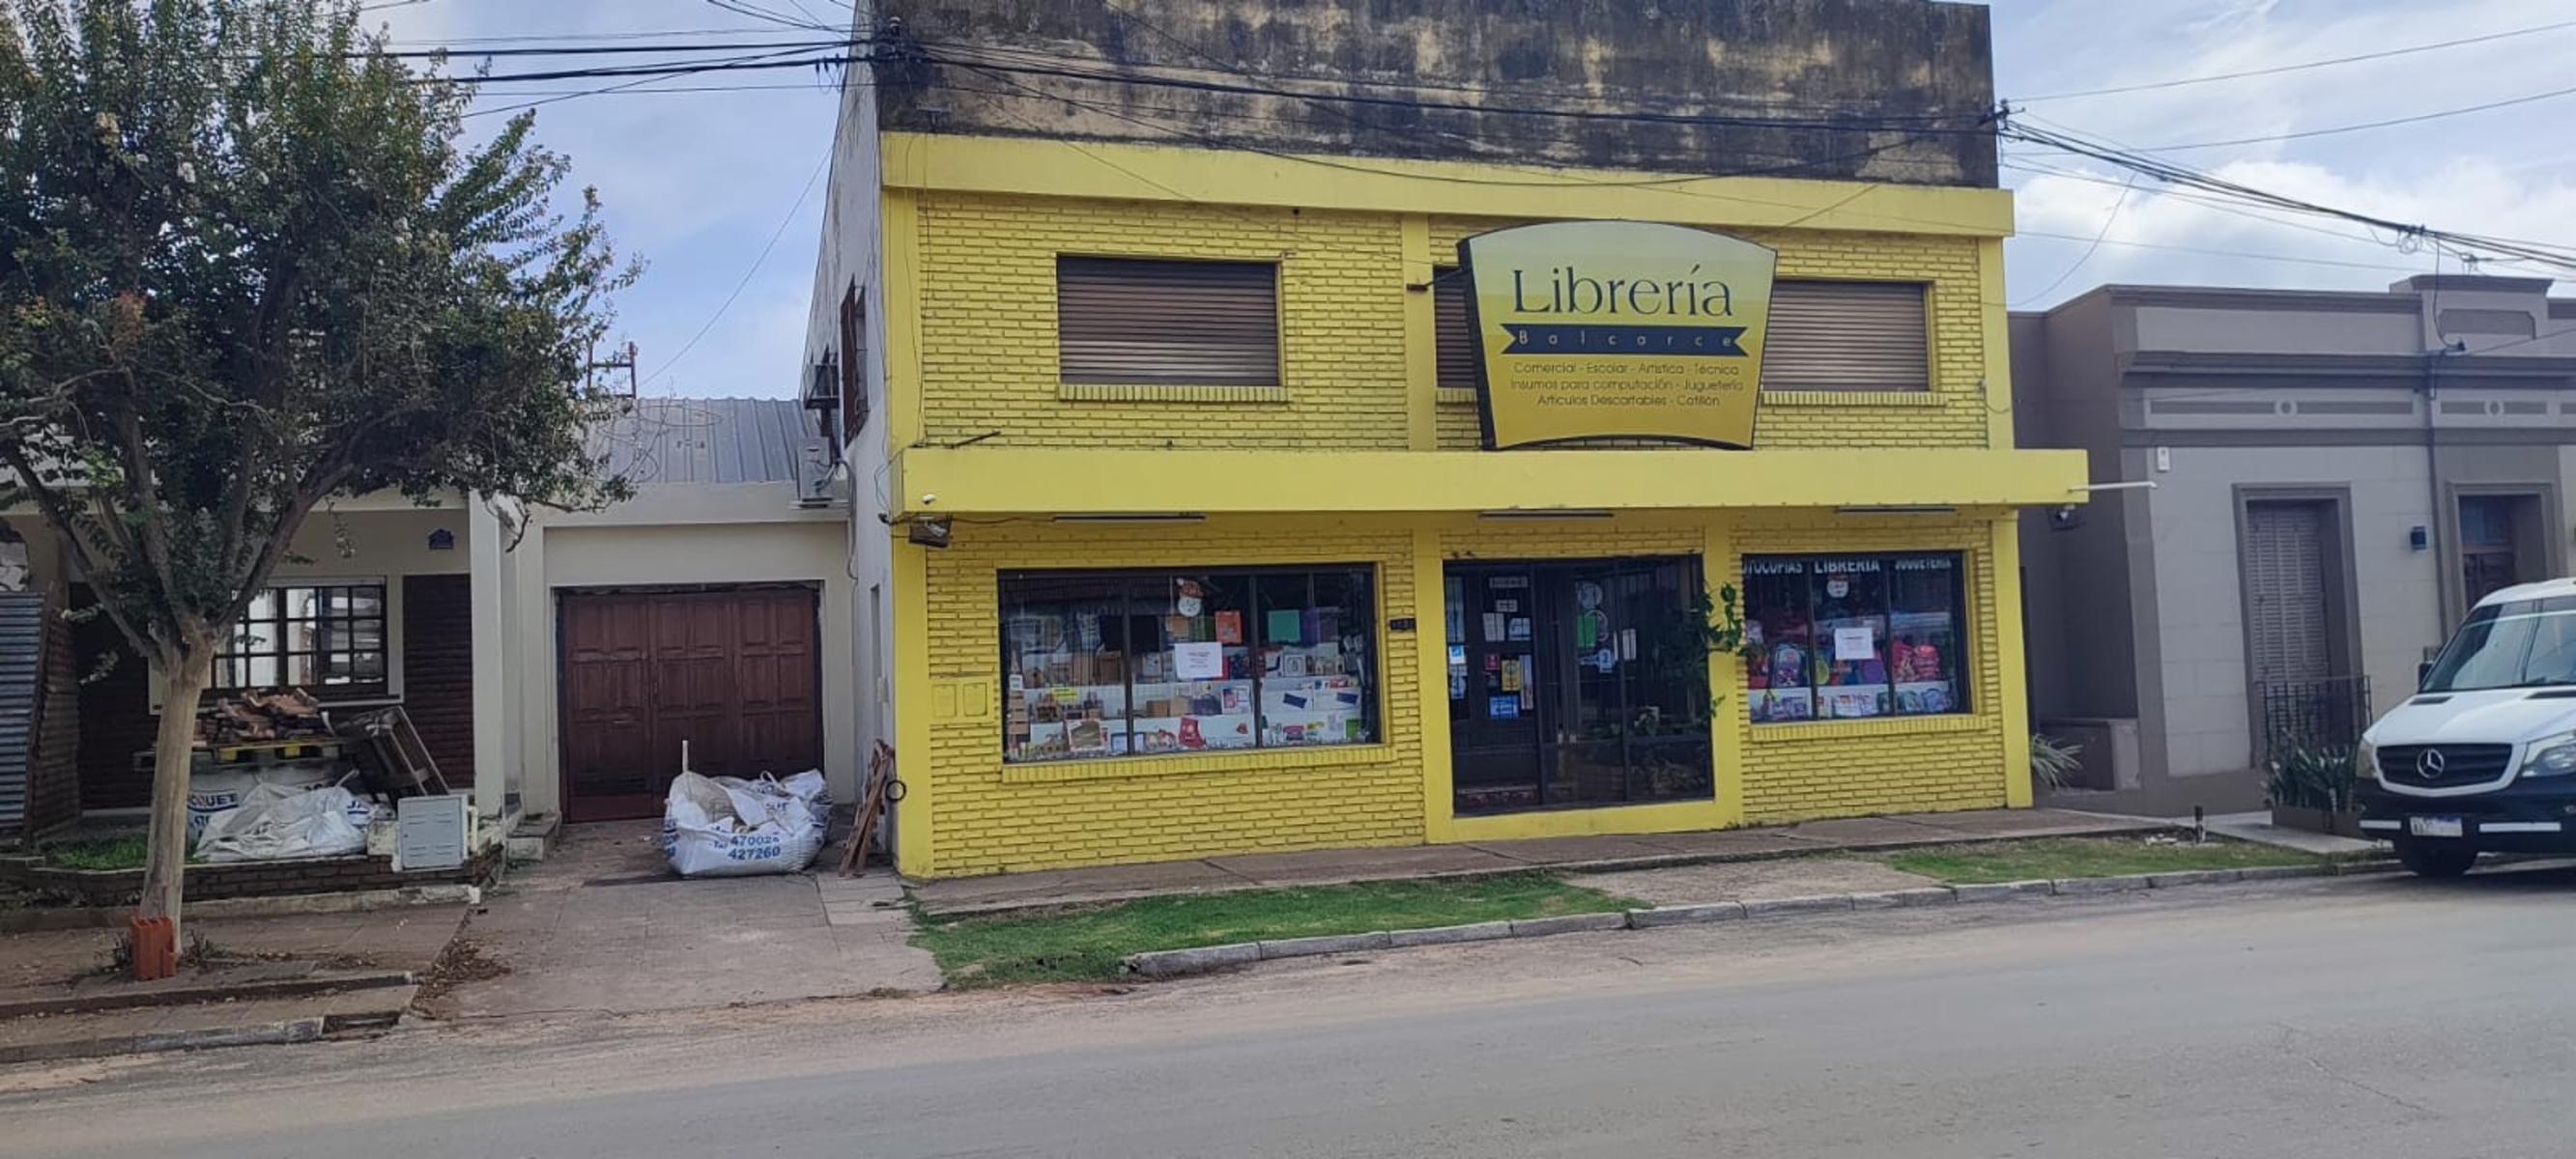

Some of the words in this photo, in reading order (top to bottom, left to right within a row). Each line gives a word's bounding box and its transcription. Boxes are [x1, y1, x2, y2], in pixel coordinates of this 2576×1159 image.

[1513, 264, 1733, 317] Librería
[1518, 329, 1732, 348] Balcarce
[1513, 362, 1576, 374] Comercial
[1586, 362, 1628, 375] Escolar
[1510, 379, 1558, 390] Insumos
[1561, 381, 1589, 391] para
[1590, 394, 1667, 406] Descartables
[727, 845, 781, 861] 427260
